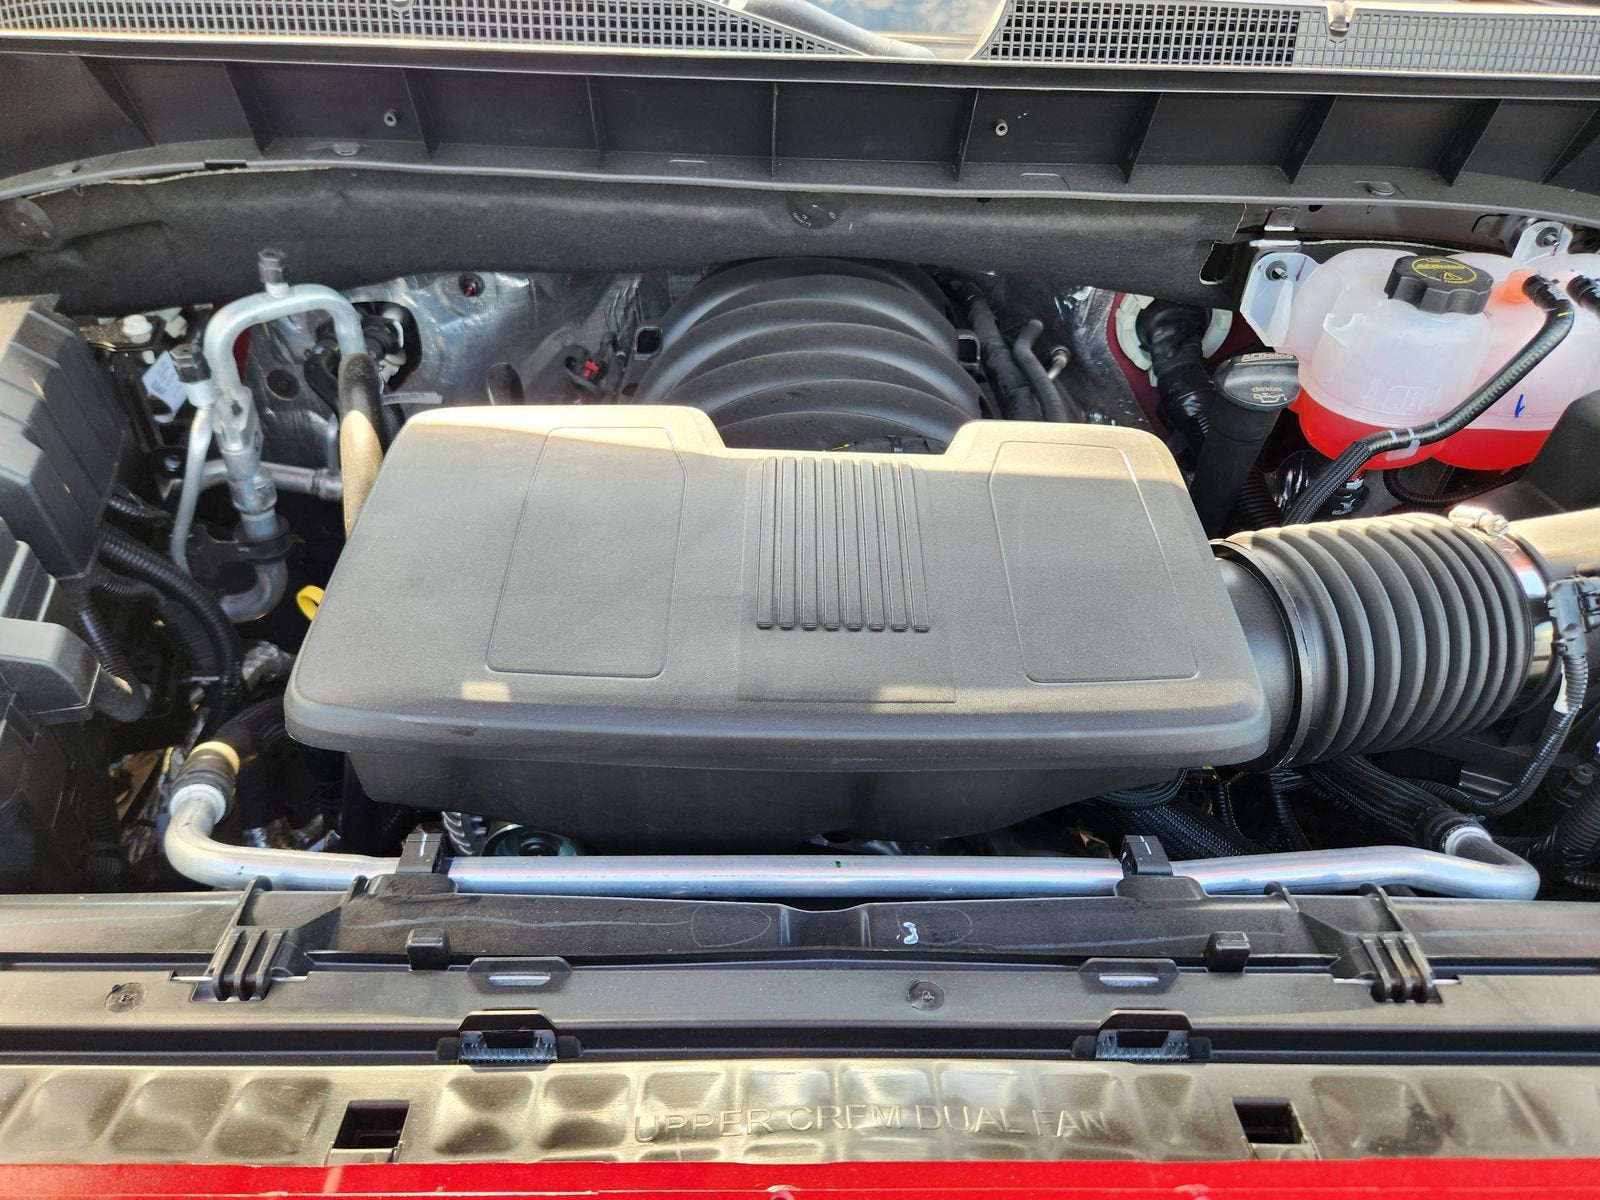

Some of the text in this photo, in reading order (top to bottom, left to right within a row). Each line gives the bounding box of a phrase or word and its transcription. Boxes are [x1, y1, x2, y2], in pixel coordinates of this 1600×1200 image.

[634, 1108, 774, 1143] UPPER
[915, 1105, 1025, 1134] DUAL
[1031, 1109, 1110, 1138] FAN
